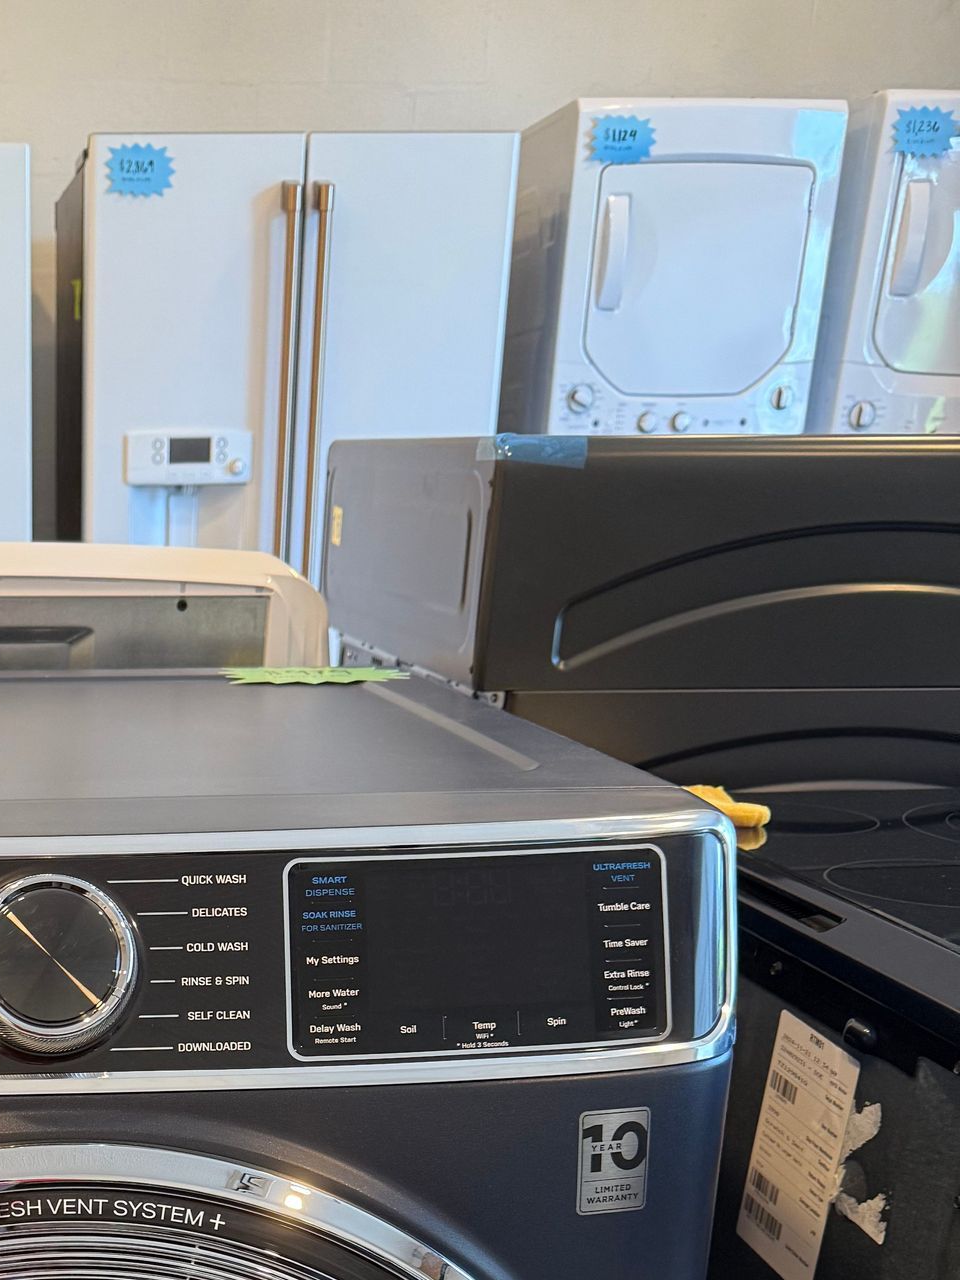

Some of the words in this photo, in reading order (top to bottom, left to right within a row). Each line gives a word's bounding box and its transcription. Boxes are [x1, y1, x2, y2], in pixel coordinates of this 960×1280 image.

[593, 862, 651, 871] ULTRAFRESH
[181, 875, 213, 886] QUICK
[216, 875, 247, 884] WASH
[312, 876, 347, 884] SMART
[611, 874, 636, 882] VENT
[305, 888, 355, 897] DISPENSE
[598, 902, 629, 911] Tumble
[630, 902, 651, 911] Care
[192, 908, 247, 917] DELICATES
[302, 911, 328, 919] SOAK
[330, 910, 356, 918] RINSE
[301, 924, 318, 932] FOR
[320, 923, 363, 931] SANITIZER
[186, 943, 214, 952] COLD
[217, 942, 248, 951] WASH
[603, 939, 623, 948] Time
[625, 938, 649, 947] Saver
[306, 957, 319, 966] My
[321, 955, 359, 966] Settings
[604, 970, 626, 980] Extra
[627, 969, 650, 978] Rinse
[181, 977, 212, 986] RINSE
[215, 977, 223, 985] &
[226, 976, 250, 985] SPIN
[630, 983, 644, 991] Lock
[308, 990, 330, 998] More
[332, 988, 359, 997] Water
[188, 1011, 213, 1020] SELF
[216, 1011, 250, 1020] CLEAN
[610, 1006, 646, 1016] PreWash
[472, 1021, 496, 1032] Temp
[547, 1017, 567, 1028] Spin
[309, 1025, 335, 1034] Delay
[336, 1023, 361, 1032] Wash
[400, 1025, 417, 1034] Soil
[340, 1036, 357, 1044] Start
[483, 1040, 509, 1048] Seconds
[178, 1042, 251, 1052] DOWNLOADED
[583, 1121, 648, 1173] 10
[592, 1142, 622, 1152] YEAR
[595, 1184, 631, 1194] LIMITED
[586, 1192, 639, 1204] WARRANTY
[46, 1198, 109, 1216] VENT
[113, 1200, 203, 1228] SYSTEM
[209, 1213, 227, 1231] +
